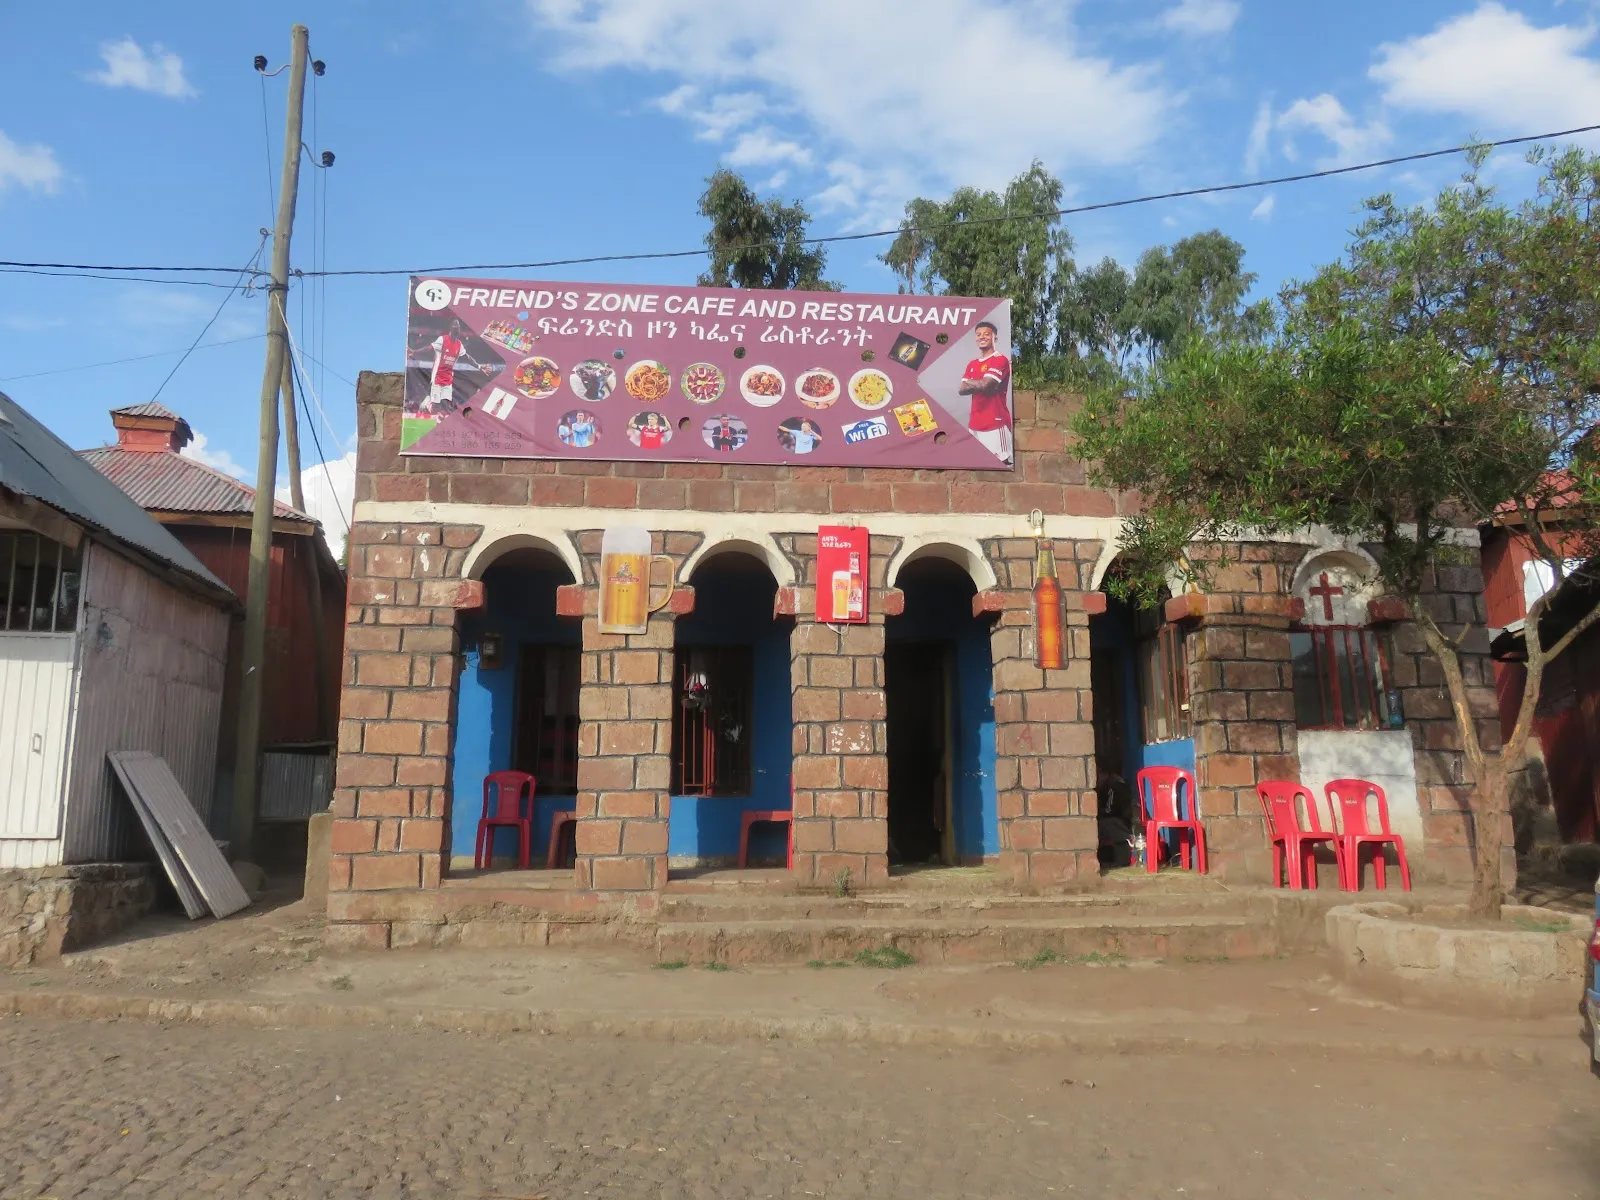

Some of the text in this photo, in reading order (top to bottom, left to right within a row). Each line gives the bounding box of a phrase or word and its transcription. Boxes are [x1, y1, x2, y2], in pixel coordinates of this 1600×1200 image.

[453, 288, 977, 327] FRIEND'S ZONE CAFE AND RESTAURANT
[538, 317, 873, 347] ፍሬንድስ ዞን ካፌና ሬስቶራንት
[849, 425, 882, 442] Wi Fi
